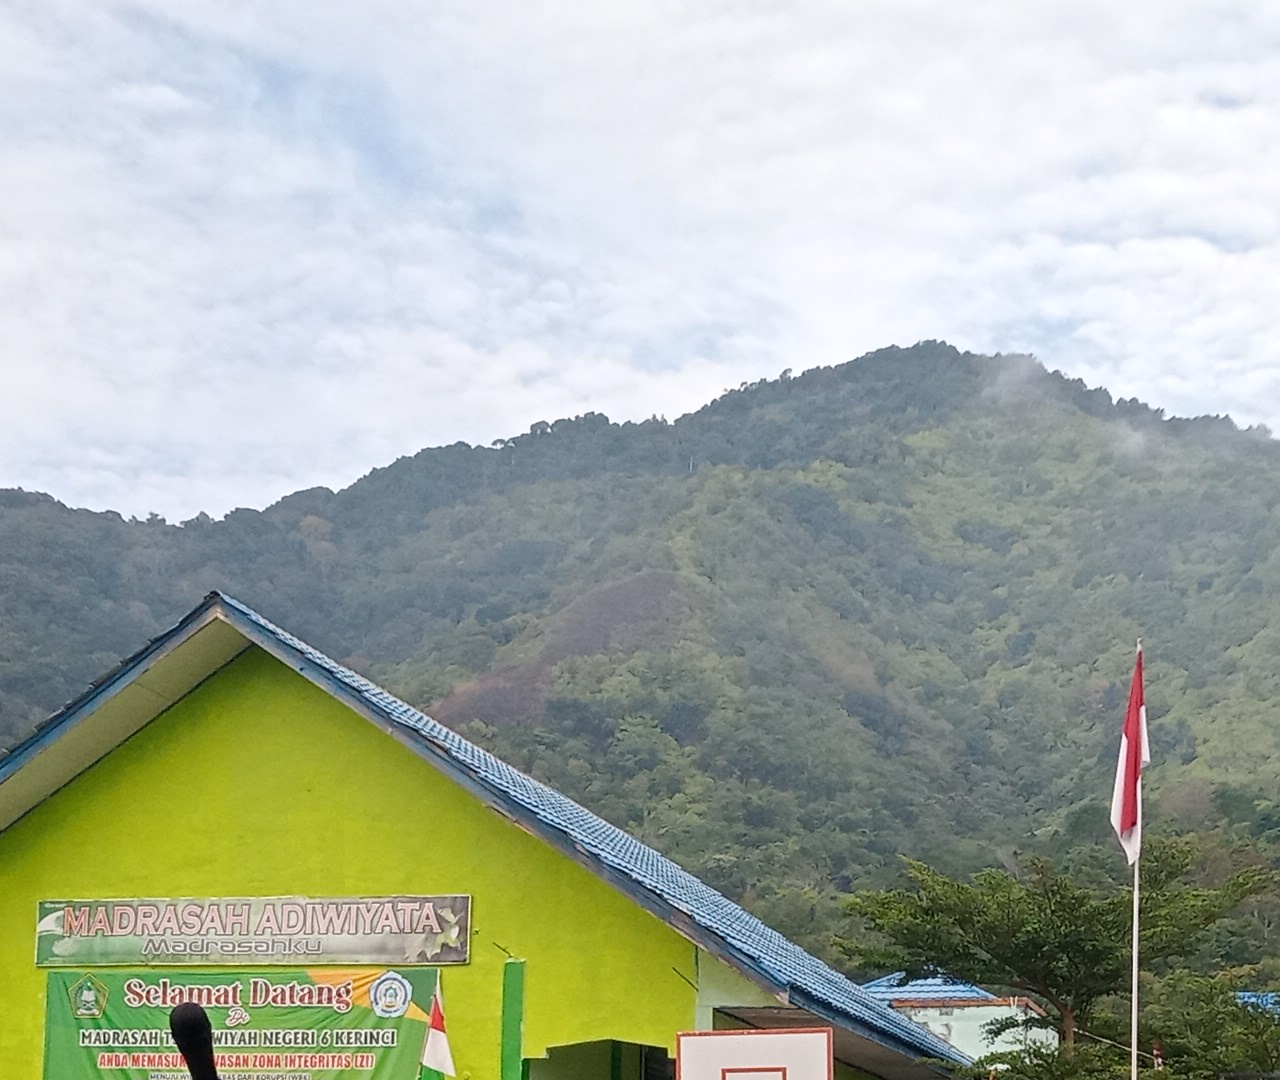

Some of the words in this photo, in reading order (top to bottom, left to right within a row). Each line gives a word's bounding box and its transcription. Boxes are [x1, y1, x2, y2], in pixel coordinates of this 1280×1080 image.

[63, 904, 249, 937] MADRASAH
[255, 902, 442, 935] ADIWIYATA
[142, 938, 322, 955] Madrasahku
[124, 979, 244, 1008] Selamat
[249, 978, 353, 1012] Datang
[81, 1031, 158, 1046] MADRASAH
[263, 1031, 315, 1046] NEGERI
[320, 1031, 330, 1046] 6
[335, 1030, 396, 1046] KERINCI
[99, 1054, 128, 1068] ANDA
[252, 1054, 281, 1068] ZONA
[284, 1054, 351, 1068] INTEGRITAS
